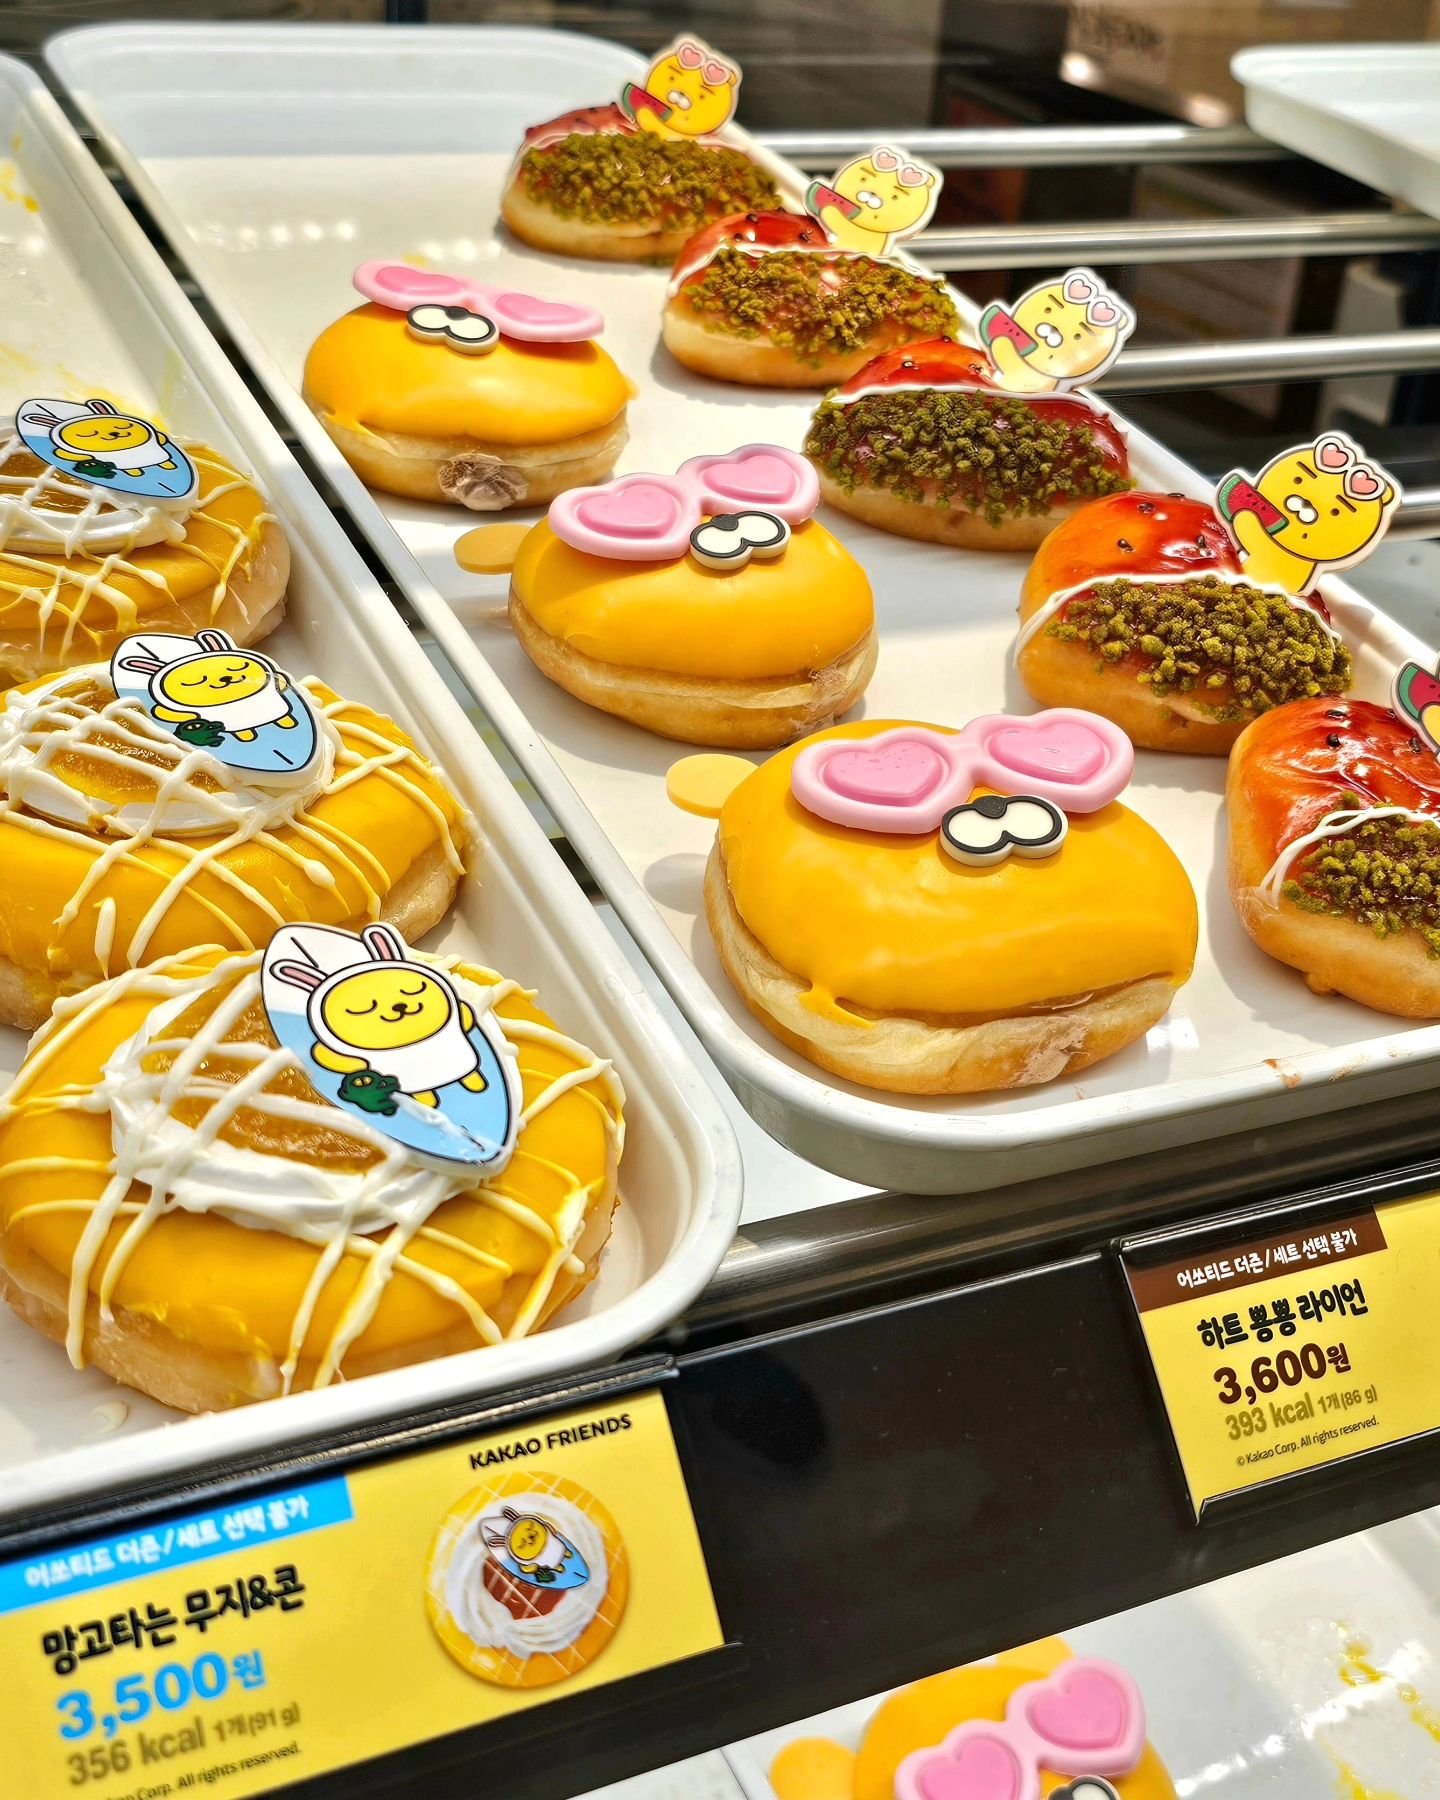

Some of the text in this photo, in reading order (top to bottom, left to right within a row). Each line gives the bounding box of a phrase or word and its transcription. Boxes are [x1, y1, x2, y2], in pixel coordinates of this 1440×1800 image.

[1177, 1260, 1235, 1288] 어쏘티드
[1302, 1237, 1331, 1259] 선택
[1331, 1228, 1357, 1251] 불가
[1197, 1312, 1249, 1349] 하트
[1296, 1278, 1369, 1323] 라이언
[1213, 1342, 1352, 1406] 3,600원
[469, 1414, 632, 1470] KAKAO FRIENDS
[1225, 1406, 1268, 1441] 393
[1269, 1391, 1315, 1428] kcal
[1246, 1448, 1274, 1465] Kakao
[1275, 1442, 1300, 1457] Corp.
[1300, 1435, 1312, 1448] All
[1313, 1429, 1339, 1445] rights
[1339, 1415, 1380, 1436] reserved.
[221, 1505, 266, 1541] 선택
[42, 1563, 307, 1675] 망고타는 무지&콘
[56, 1648, 267, 1740] 3,500원
[67, 1739, 131, 1787] 356
[138, 1716, 206, 1766] kcal
[178, 1772, 195, 1789] All
[198, 1762, 238, 1784] rights
